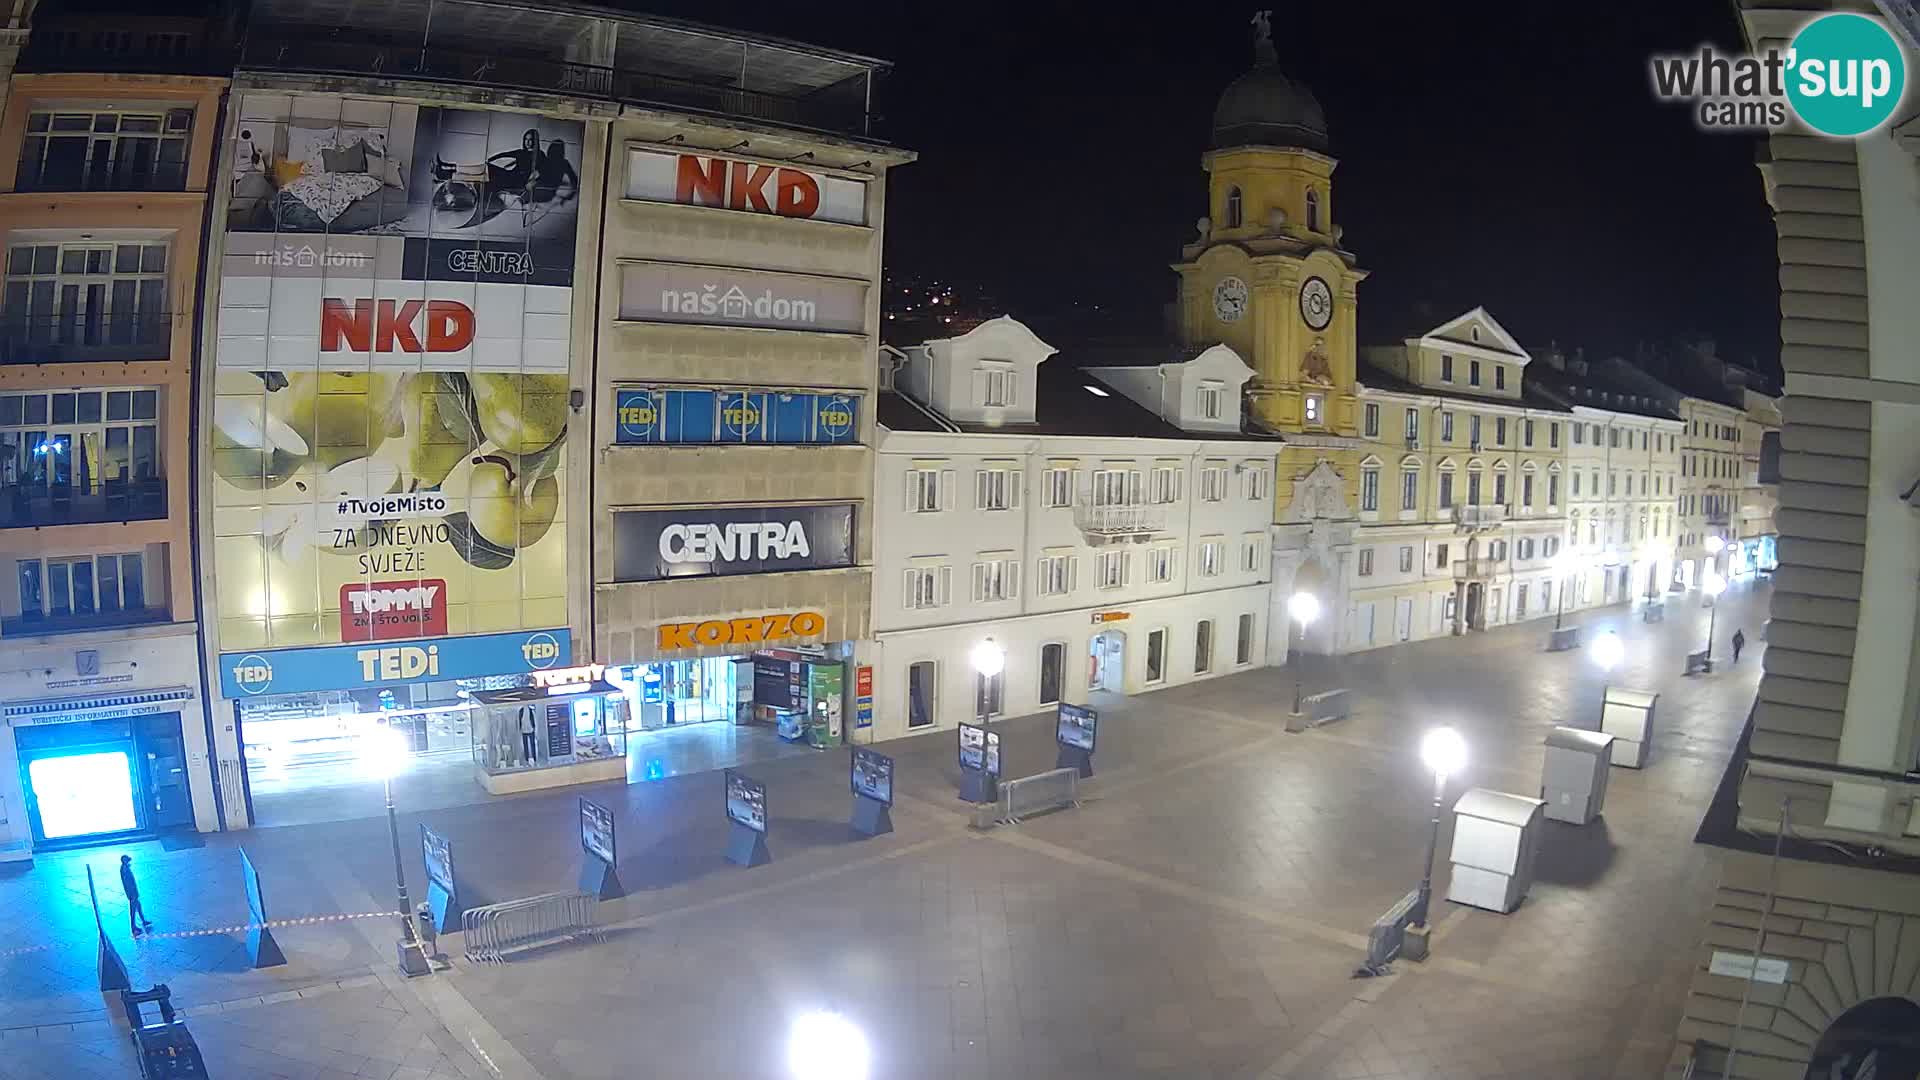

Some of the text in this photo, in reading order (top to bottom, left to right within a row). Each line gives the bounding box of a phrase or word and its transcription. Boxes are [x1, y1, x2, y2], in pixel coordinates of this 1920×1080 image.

[677, 154, 821, 219] NKD
[254, 245, 365, 268] naš dom
[448, 248, 534, 275] CENTRA
[661, 283, 816, 322] naš dom
[320, 297, 477, 353] NKD
[337, 495, 445, 517] #TvojeMisto
[333, 522, 450, 548] ZA DNEVNO
[658, 520, 810, 564] CENTRA
[359, 547, 426, 574] SVJEŽE
[348, 585, 439, 613] TOMMY
[656, 612, 825, 649] KORZO
[357, 644, 439, 681] TEDi
[521, 642, 560, 660] TEDi
[233, 665, 273, 684] TEDi
